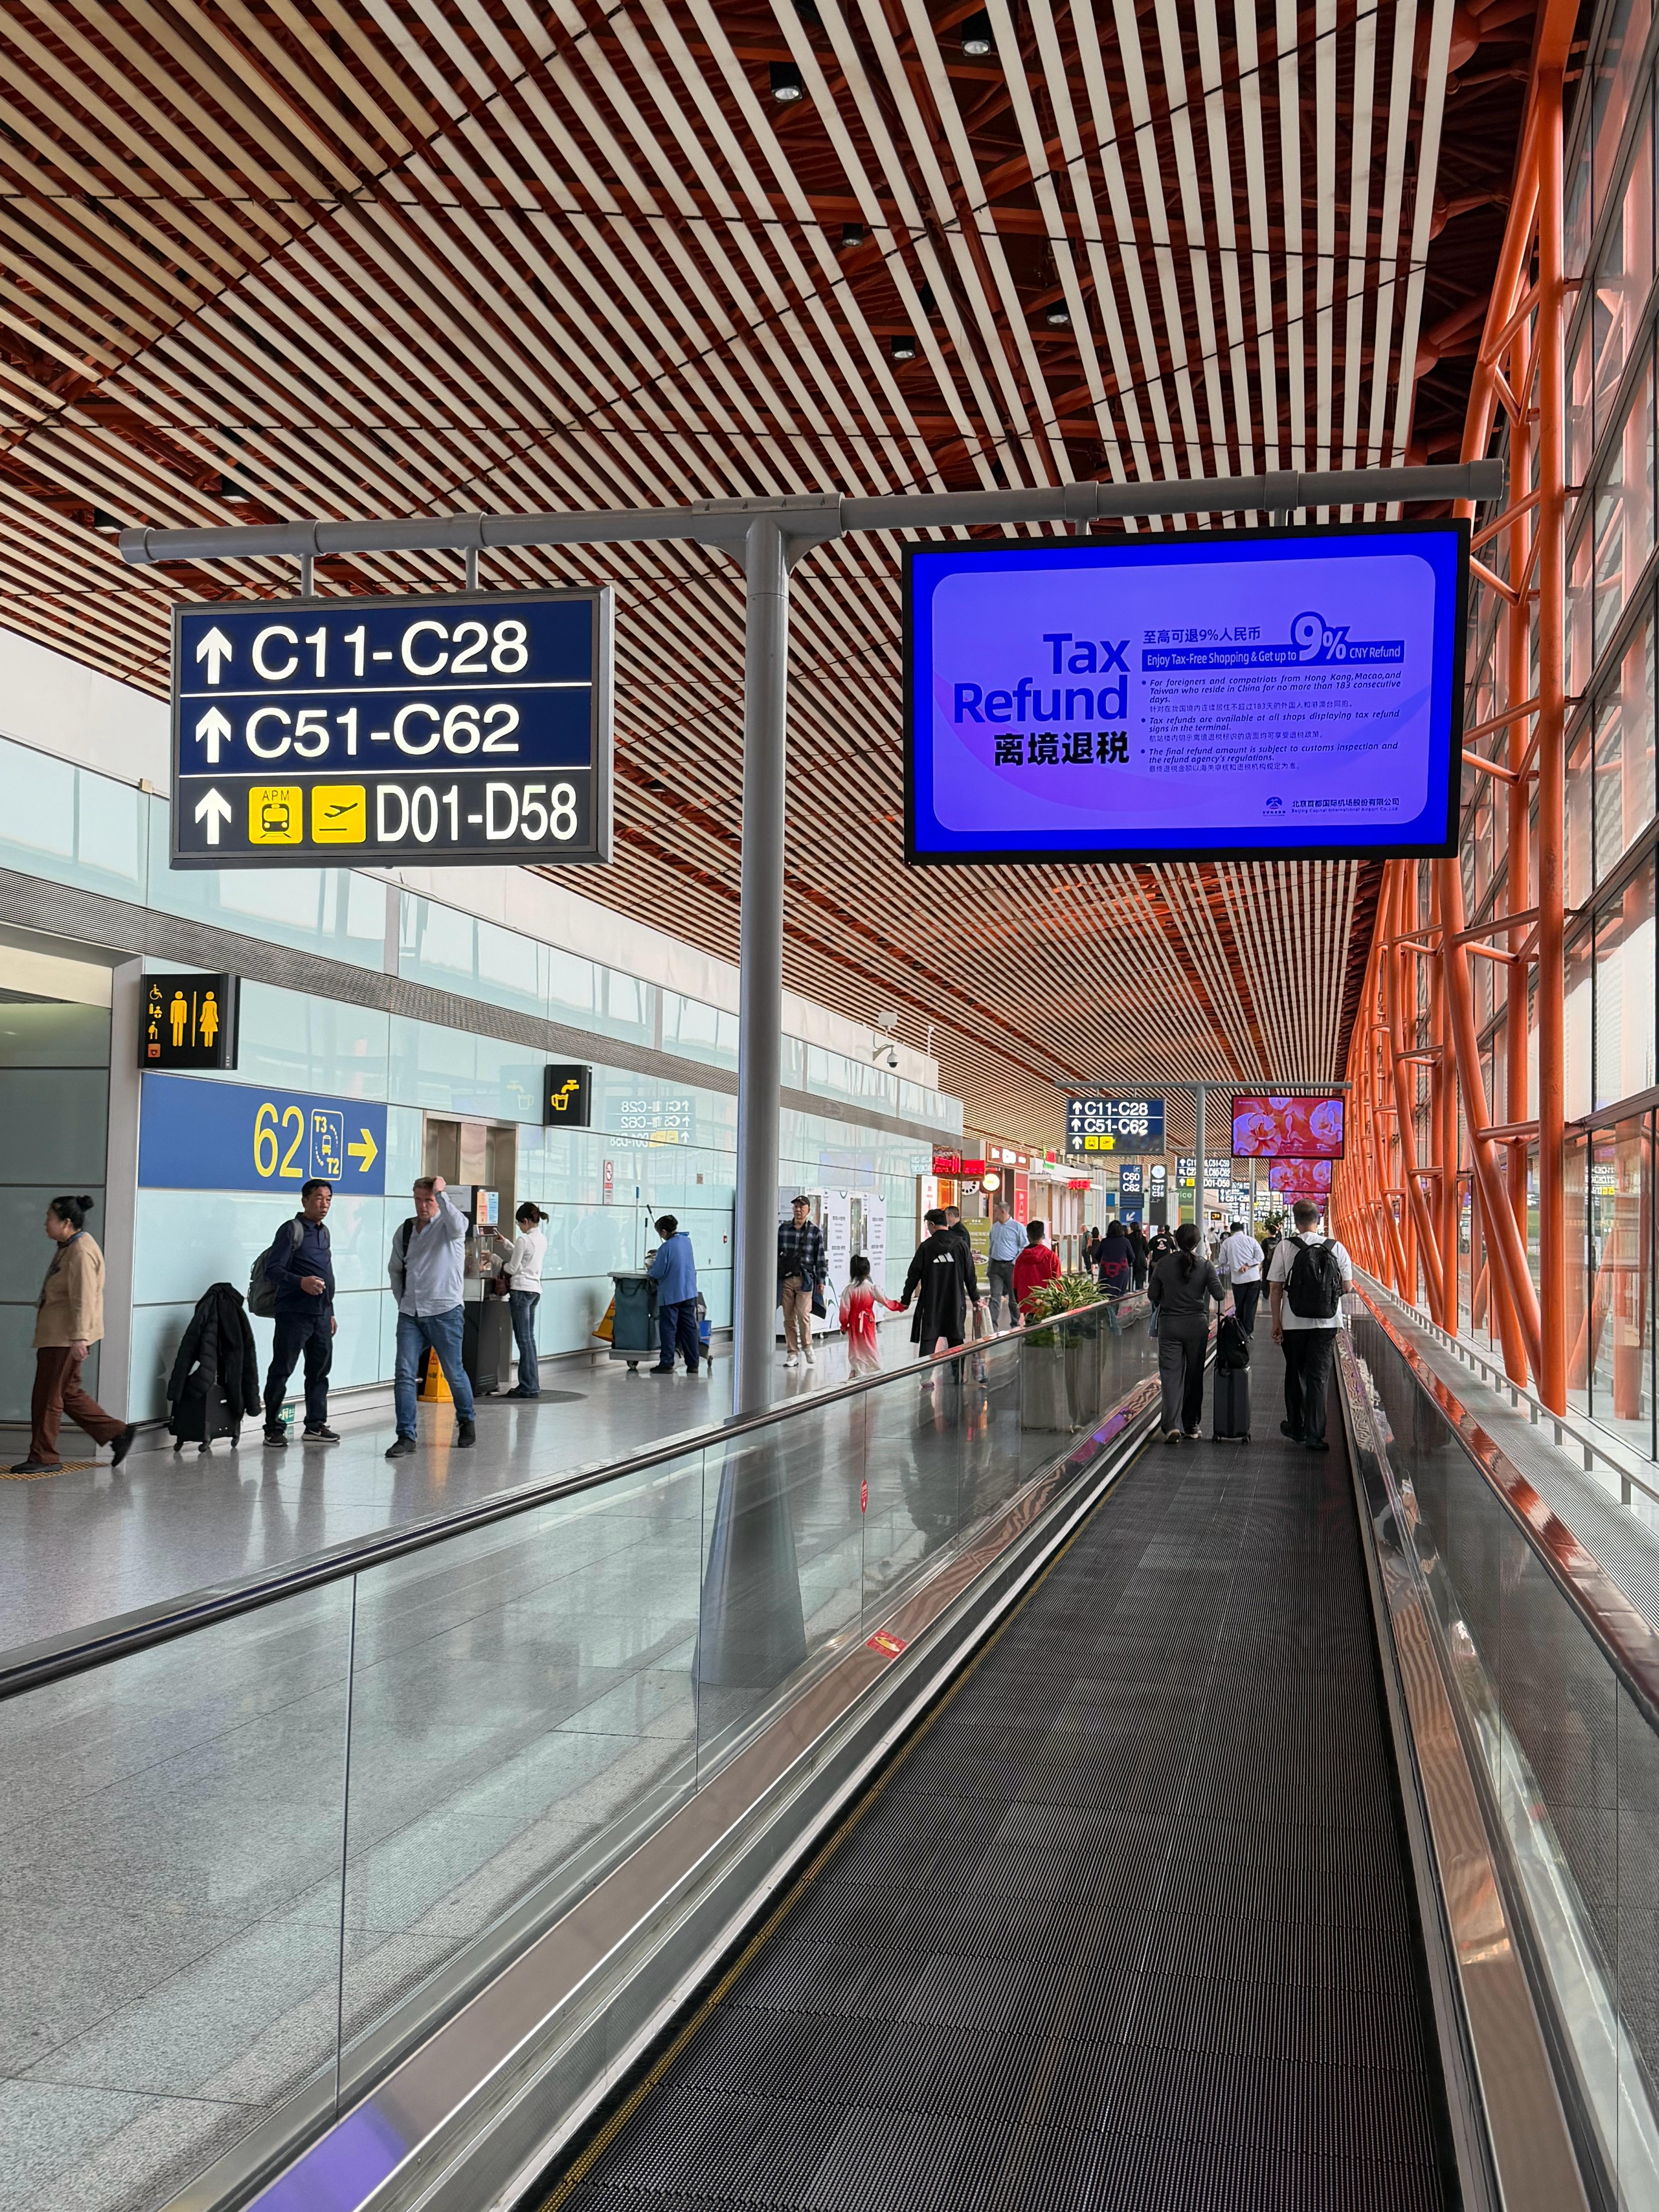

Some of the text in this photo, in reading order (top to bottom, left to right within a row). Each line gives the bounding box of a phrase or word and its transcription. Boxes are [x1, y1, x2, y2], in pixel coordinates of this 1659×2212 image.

[1143, 626, 1261, 644] 至高可退9%人民币
[1147, 615, 1400, 668] Enjoy Tax-Free Shopping & Get up to 9% CNY Refund
[252, 620, 528, 680] C11-C28
[1043, 633, 1131, 674] Tax
[1166, 678, 1206, 687] foreigners
[1229, 675, 1277, 685] compatriots
[1281, 675, 1300, 684] from
[1262, 684, 1274, 692] for
[1353, 680, 1401, 689] consecutive
[954, 675, 1128, 723] Refund
[1150, 696, 1170, 704] days.
[1166, 716, 1196, 725] refunds
[1216, 714, 1253, 723] available
[1283, 713, 1305, 722] shops
[1309, 711, 1352, 721] displaying
[1373, 709, 1400, 720] refund
[246, 703, 519, 758] C51-C62
[1149, 725, 1169, 734] signs
[1195, 723, 1231, 731] terminal.
[994, 731, 1130, 766] 离境退税
[1166, 747, 1184, 756] final
[1187, 747, 1213, 756] refund
[1259, 745, 1287, 754] subject
[1337, 742, 1378, 752] inspection
[1163, 756, 1189, 764] refund
[1191, 754, 1225, 764] agency's
[1227, 754, 1274, 763] regulations.
[262, 790, 290, 801] APM
[377, 783, 577, 843] D01-D58
[1084, 1101, 1148, 1116] C11-C28
[314, 1116, 327, 1133] T3
[1084, 1118, 1149, 1133] C51-C62
[253, 1103, 304, 1178] 62
[327, 1158, 339, 1175] T2
